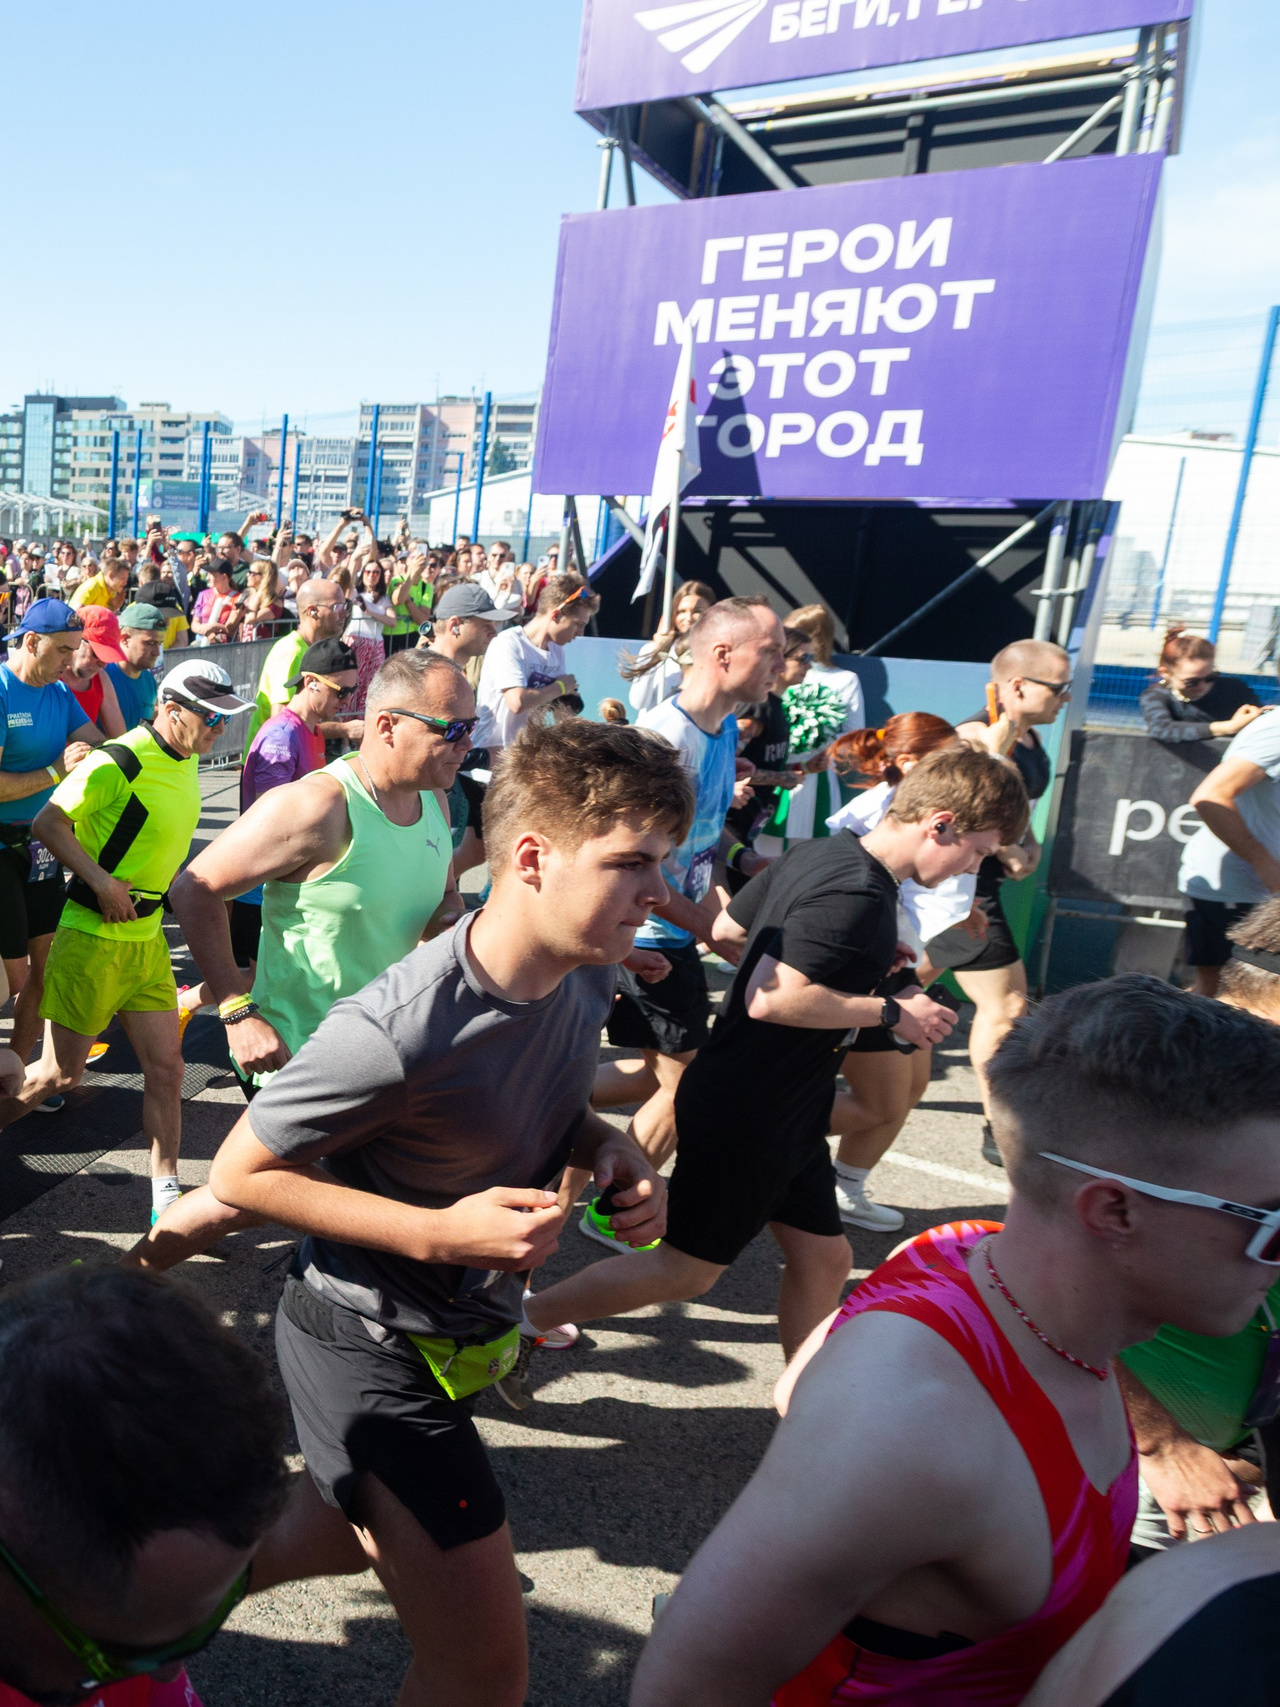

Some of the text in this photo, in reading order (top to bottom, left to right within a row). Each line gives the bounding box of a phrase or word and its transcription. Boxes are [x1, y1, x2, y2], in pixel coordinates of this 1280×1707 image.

[768, 0, 901, 43] БЕГИ,
[701, 217, 953, 285] ГЕРОИ
[653, 278, 996, 346] МЕНЯЮТ
[707, 347, 911, 401] ЭТОТ
